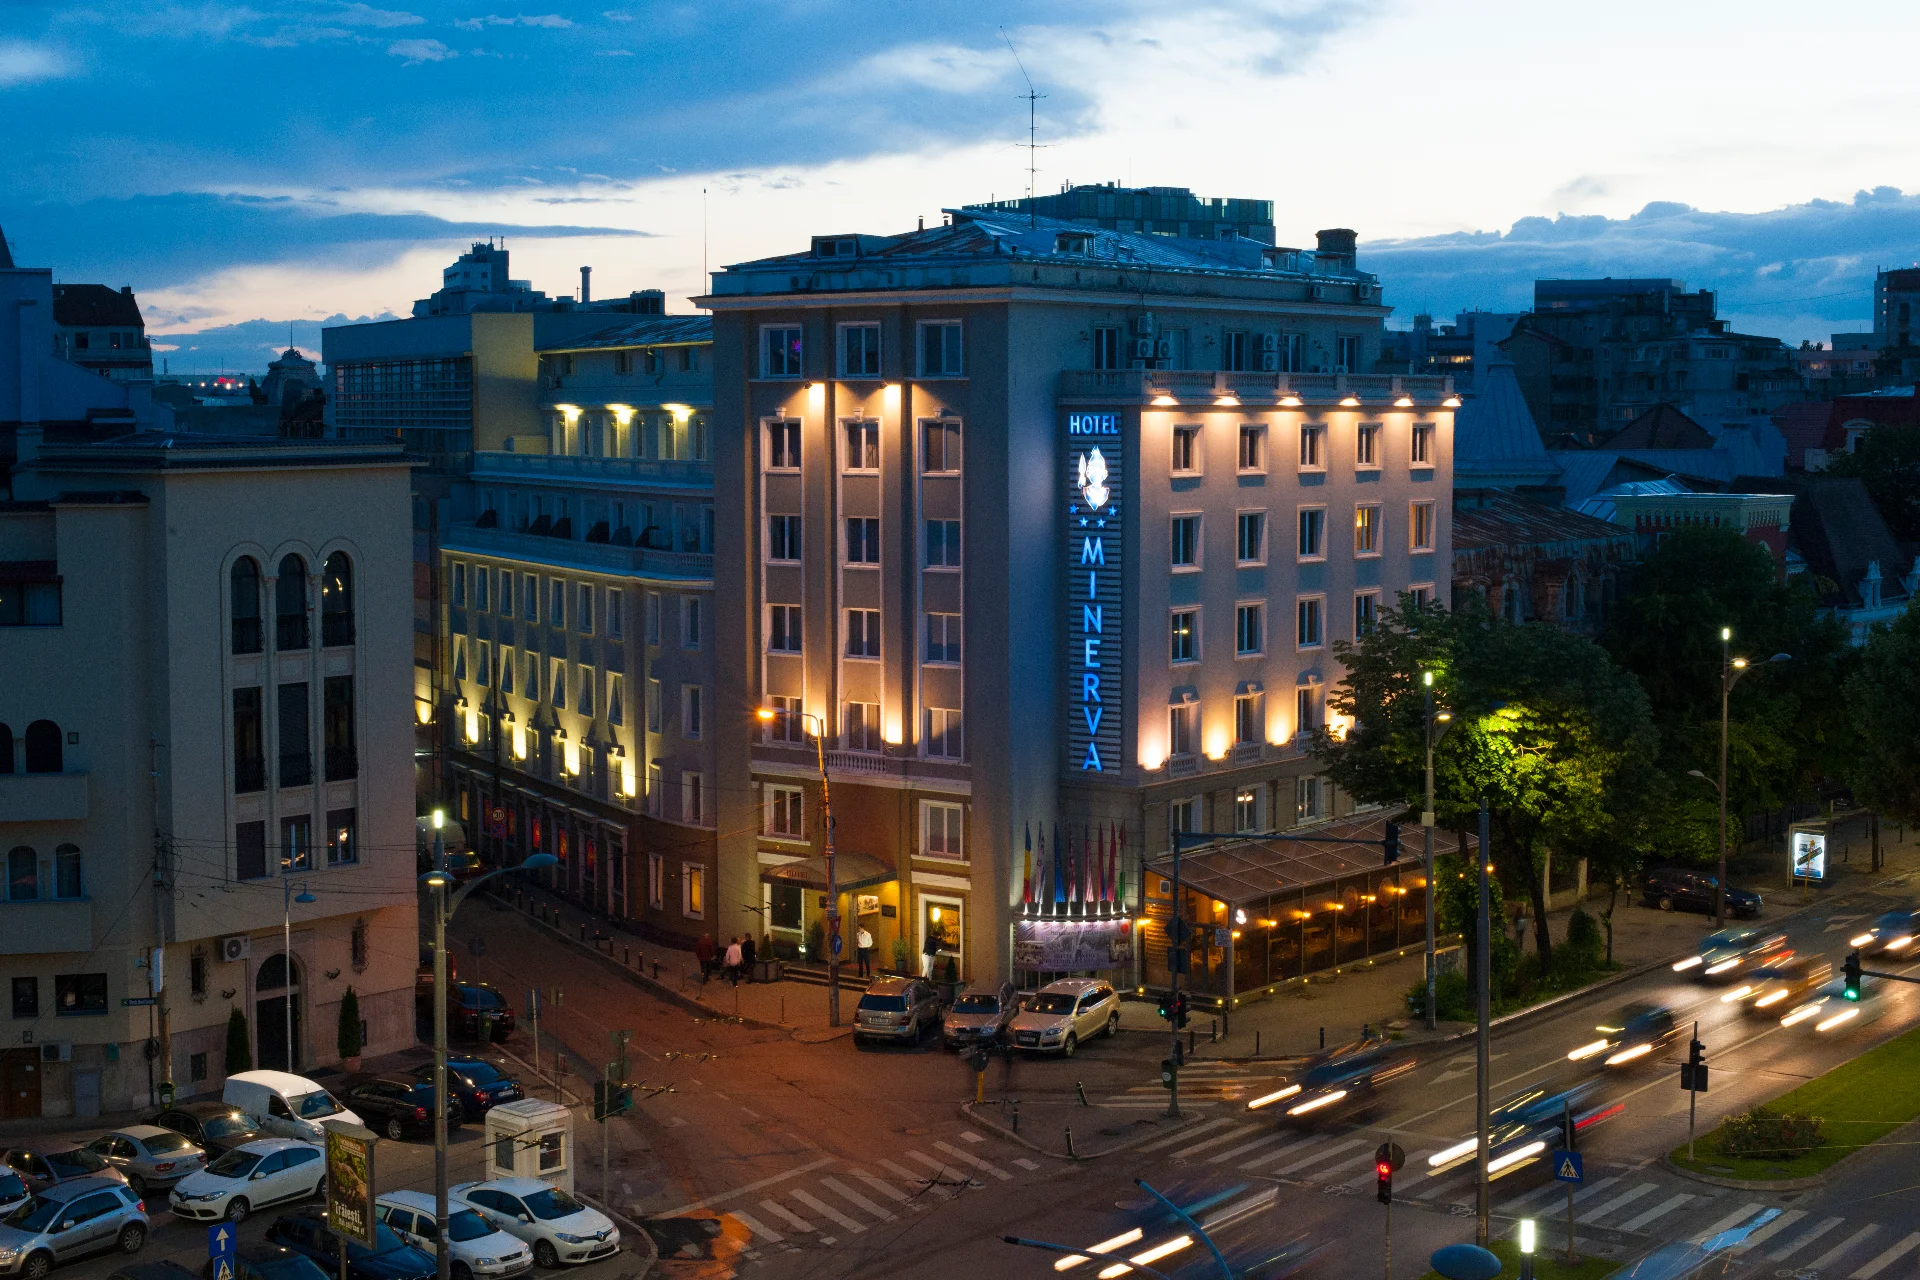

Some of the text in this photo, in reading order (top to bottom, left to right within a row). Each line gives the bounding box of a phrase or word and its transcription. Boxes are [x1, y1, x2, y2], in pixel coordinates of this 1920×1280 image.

[1070, 415, 1118, 434] HOTEL
[1081, 536, 1105, 772] MINERVA
[494, 811, 503, 819] 30
